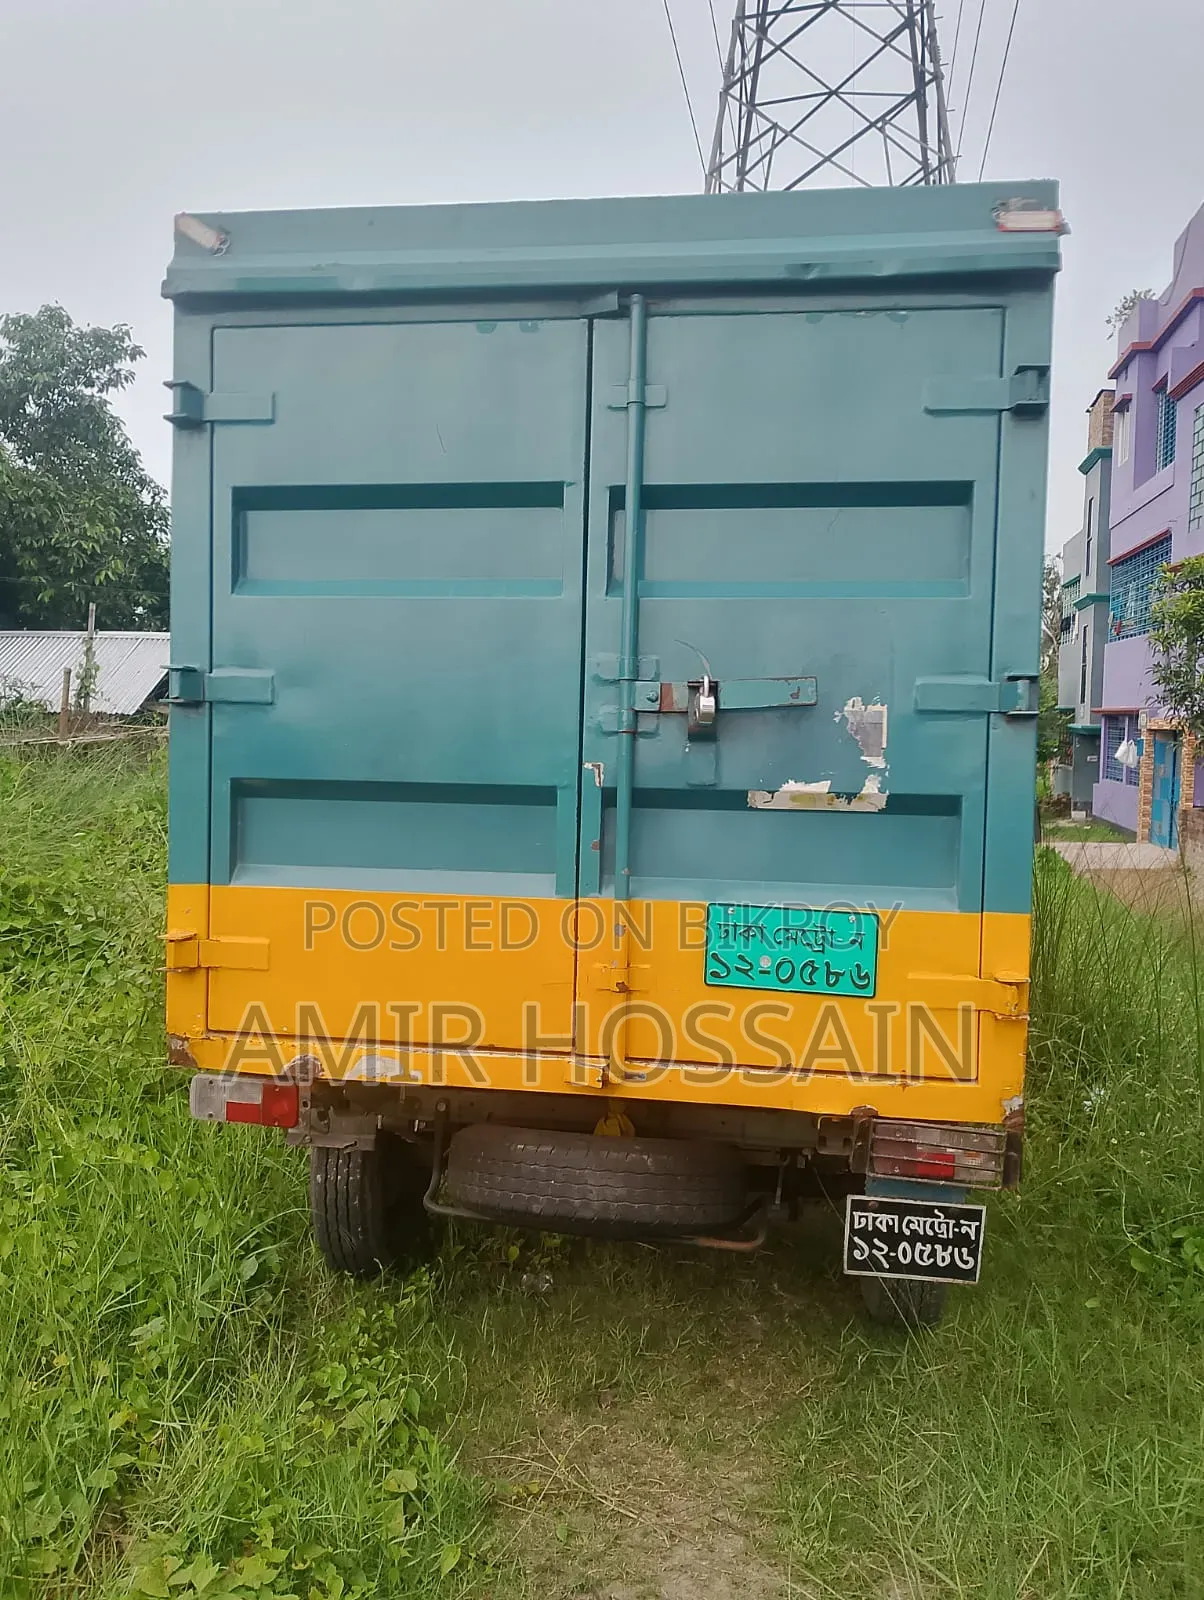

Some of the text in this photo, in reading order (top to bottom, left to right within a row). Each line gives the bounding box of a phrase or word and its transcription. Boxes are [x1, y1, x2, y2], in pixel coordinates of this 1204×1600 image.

[717, 922, 767, 944] ঢাকা
[709, 952, 871, 990] ১২-০৫৮৬
[852, 1211, 899, 1234] ঢাকা
[852, 1236, 976, 1270] ১২-০৫৮৬
